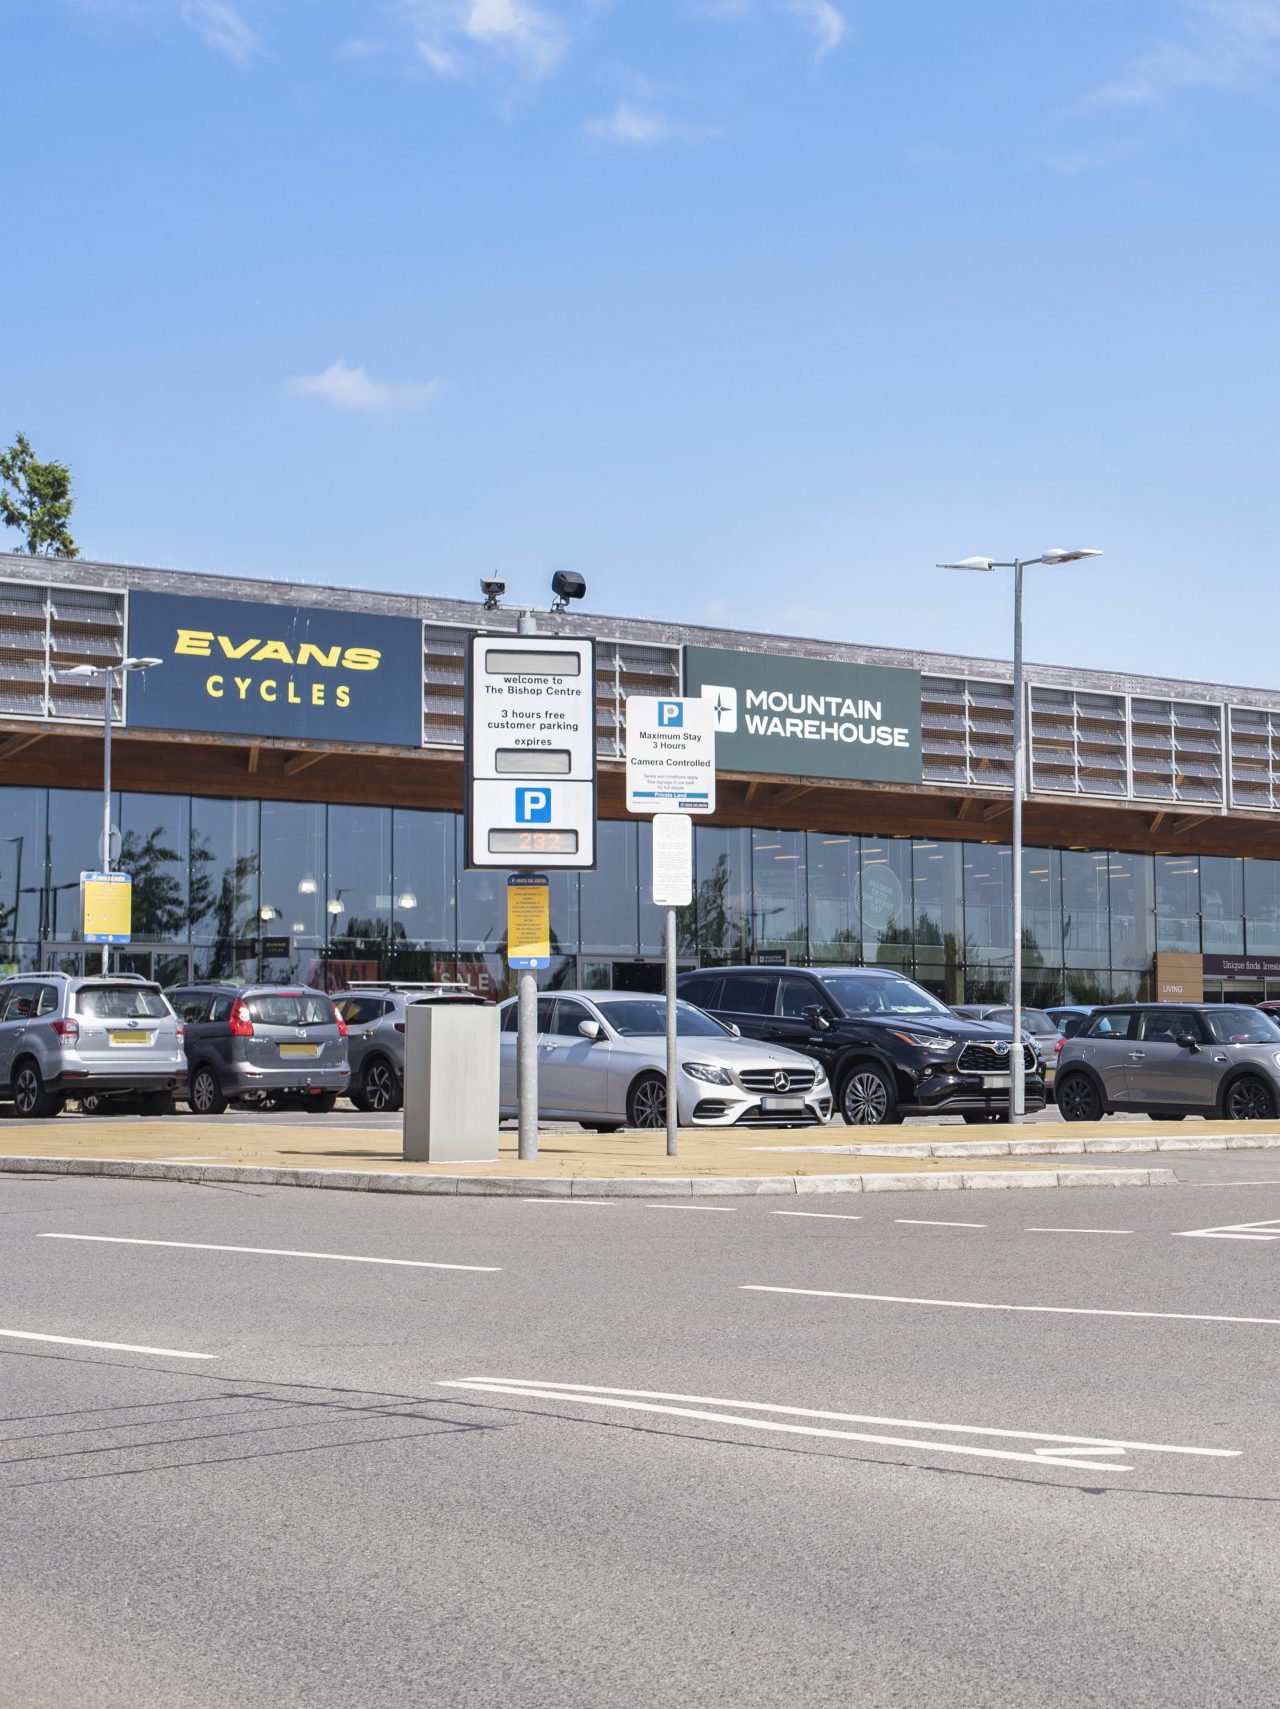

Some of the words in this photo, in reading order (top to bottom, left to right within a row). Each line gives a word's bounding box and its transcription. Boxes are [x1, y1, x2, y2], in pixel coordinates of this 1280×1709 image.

[174, 629, 382, 671] EVANS
[503, 675, 549, 684] welcome
[552, 676, 563, 685] to
[206, 674, 350, 708] CYCLES
[485, 685, 504, 694] The
[508, 686, 542, 696] Bishop
[546, 686, 582, 696] Centre
[745, 688, 882, 721] MOUNTAIN
[501, 710, 508, 718] 3
[512, 710, 541, 719] hours
[545, 710, 566, 720] free
[487, 721, 535, 730] customer
[540, 722, 579, 732] parking
[744, 714, 910, 748] WAREHOUSE
[514, 737, 552, 747] expires
[640, 732, 681, 740] Maximum
[683, 733, 702, 742] Stay
[631, 758, 664, 766] Camera
[666, 759, 711, 767] Controlled
[1222, 960, 1245, 971] Unique
[1163, 985, 1183, 993] LIVING
